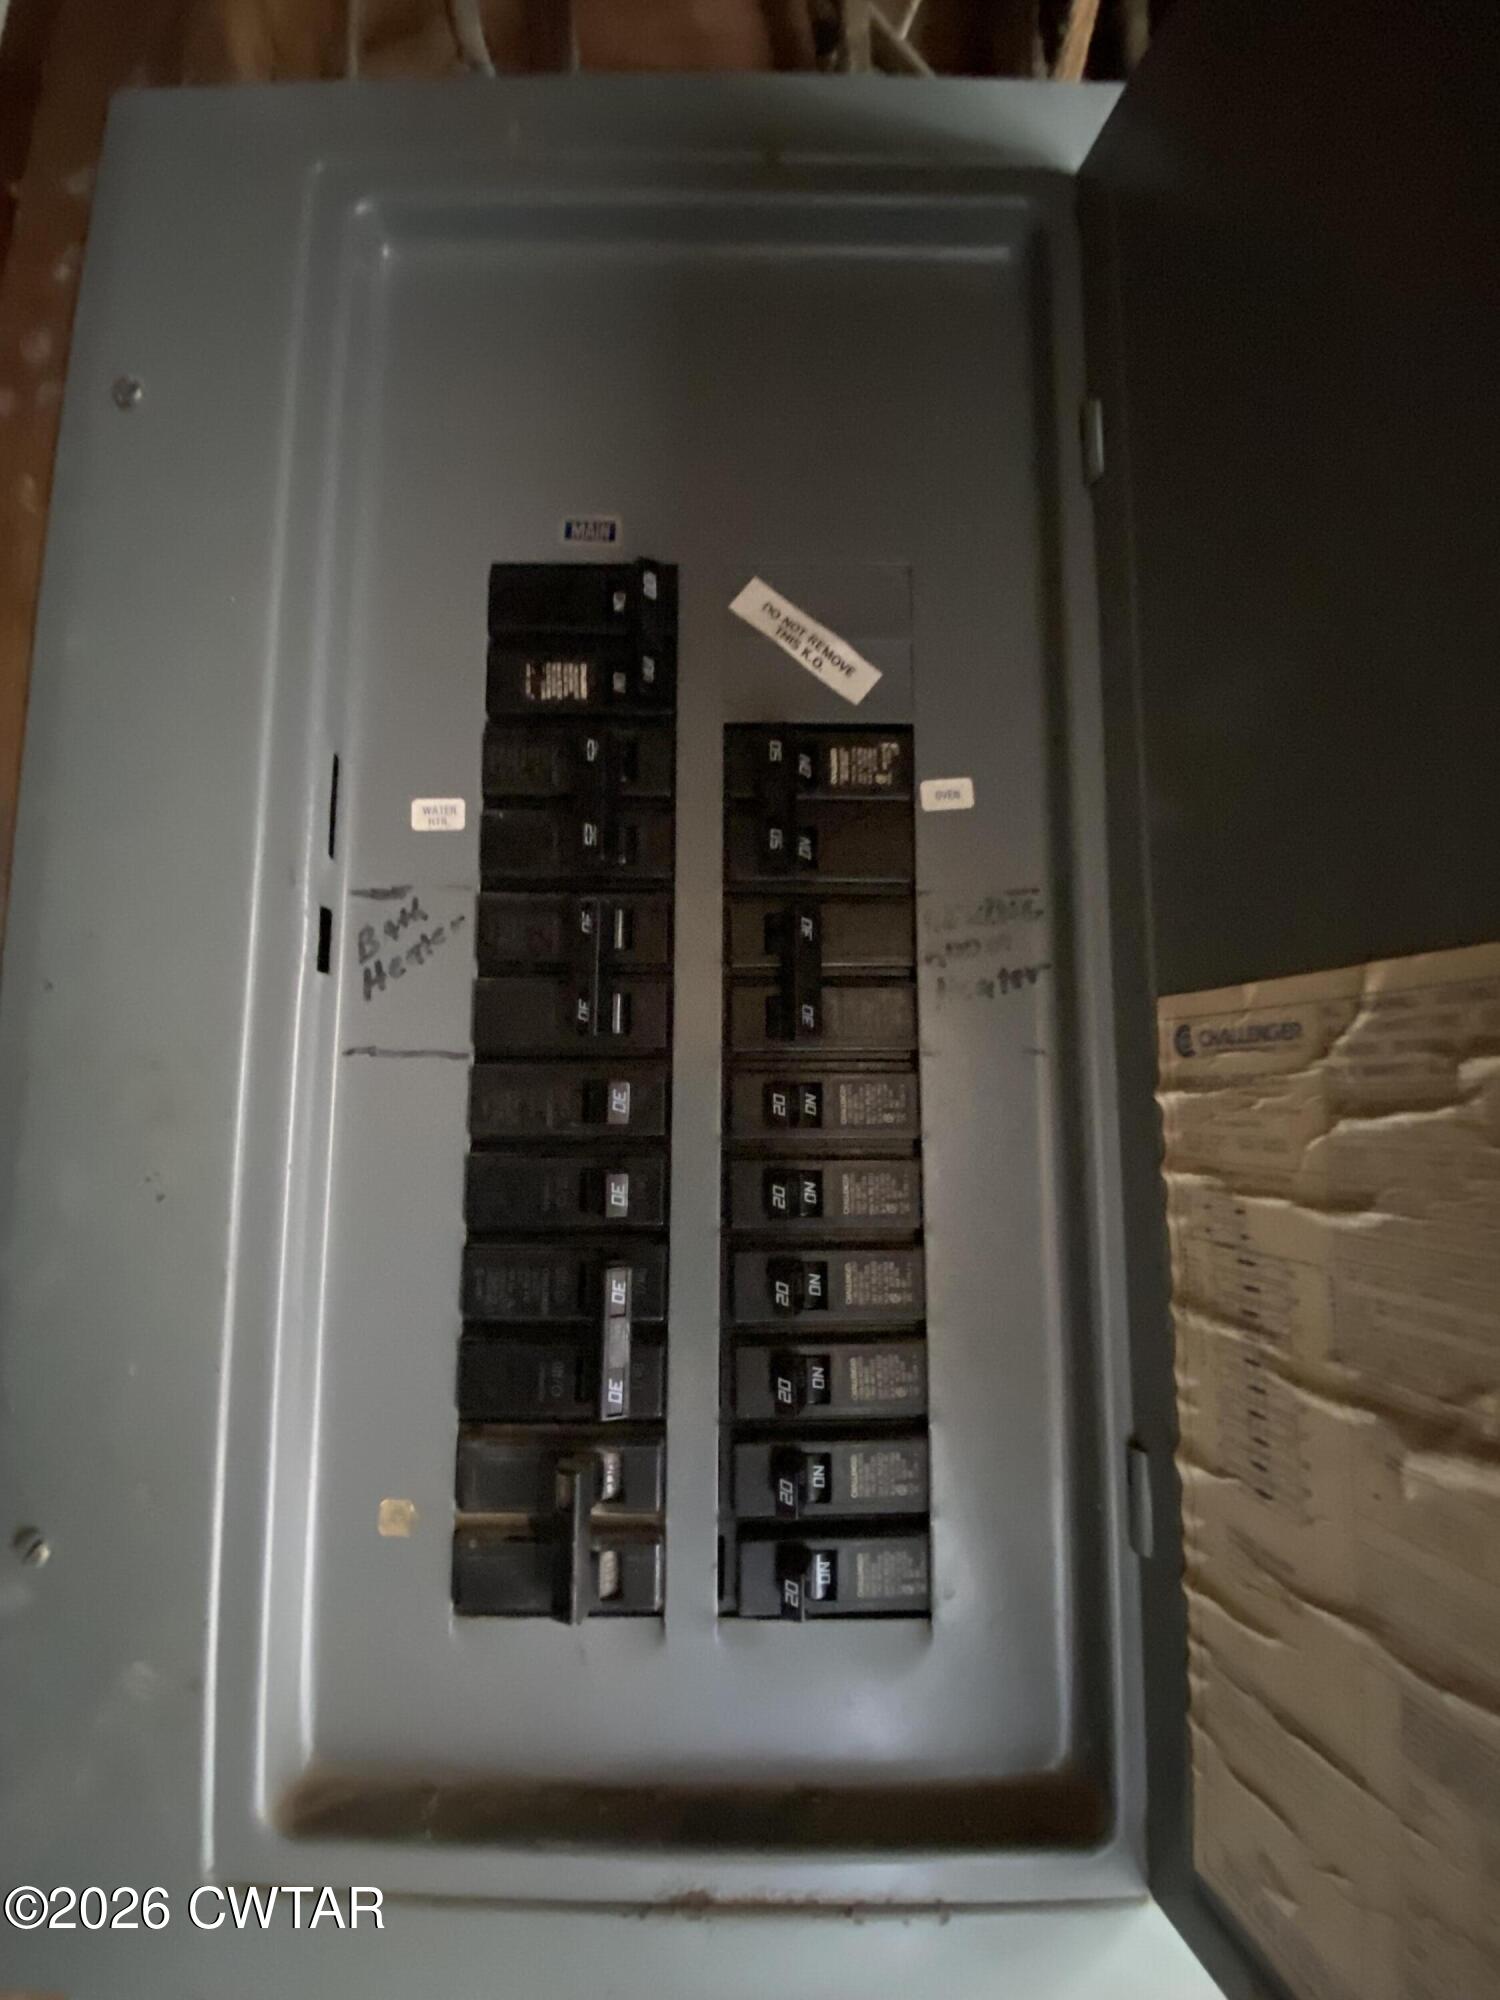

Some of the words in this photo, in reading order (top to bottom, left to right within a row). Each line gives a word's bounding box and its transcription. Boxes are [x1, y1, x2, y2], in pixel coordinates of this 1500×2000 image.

[572, 520, 609, 541] MAIN
[762, 602, 780, 619] DO
[783, 616, 806, 637] NOT
[808, 633, 856, 678] REMOVE
[776, 625, 800, 651] THIS
[612, 1088, 627, 1113] 30
[772, 1093, 786, 1117] 20
[805, 1092, 817, 1116] ON
[611, 1182, 626, 1207] 30
[772, 1184, 786, 1209] 20
[804, 1181, 817, 1204] ON
[611, 1279, 627, 1305] 30
[775, 1281, 790, 1307] 20
[808, 1273, 821, 1297] ON
[812, 1366, 824, 1389] ON
[608, 1378, 623, 1404] 30
[777, 1377, 792, 1404] 20
[813, 1465, 825, 1488] ON
[779, 1478, 793, 1506] 20
[785, 1579, 799, 1608] 20
